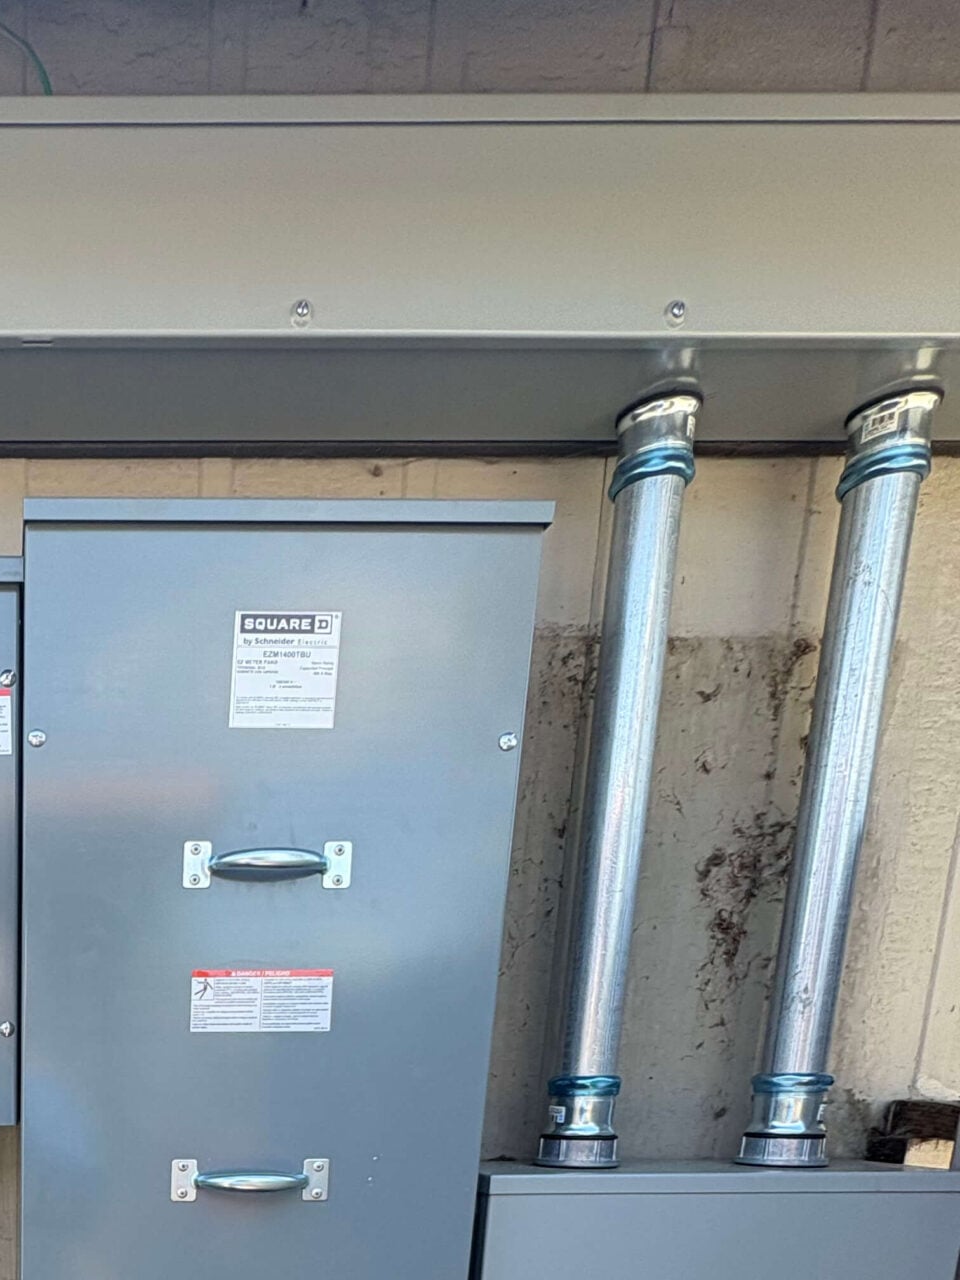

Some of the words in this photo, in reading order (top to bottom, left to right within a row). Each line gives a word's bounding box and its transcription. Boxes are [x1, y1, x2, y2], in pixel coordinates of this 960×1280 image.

[244, 618, 311, 630] SQUARE
[317, 619, 329, 630] D
[243, 638, 252, 646] by
[254, 637, 294, 645] Schneider
